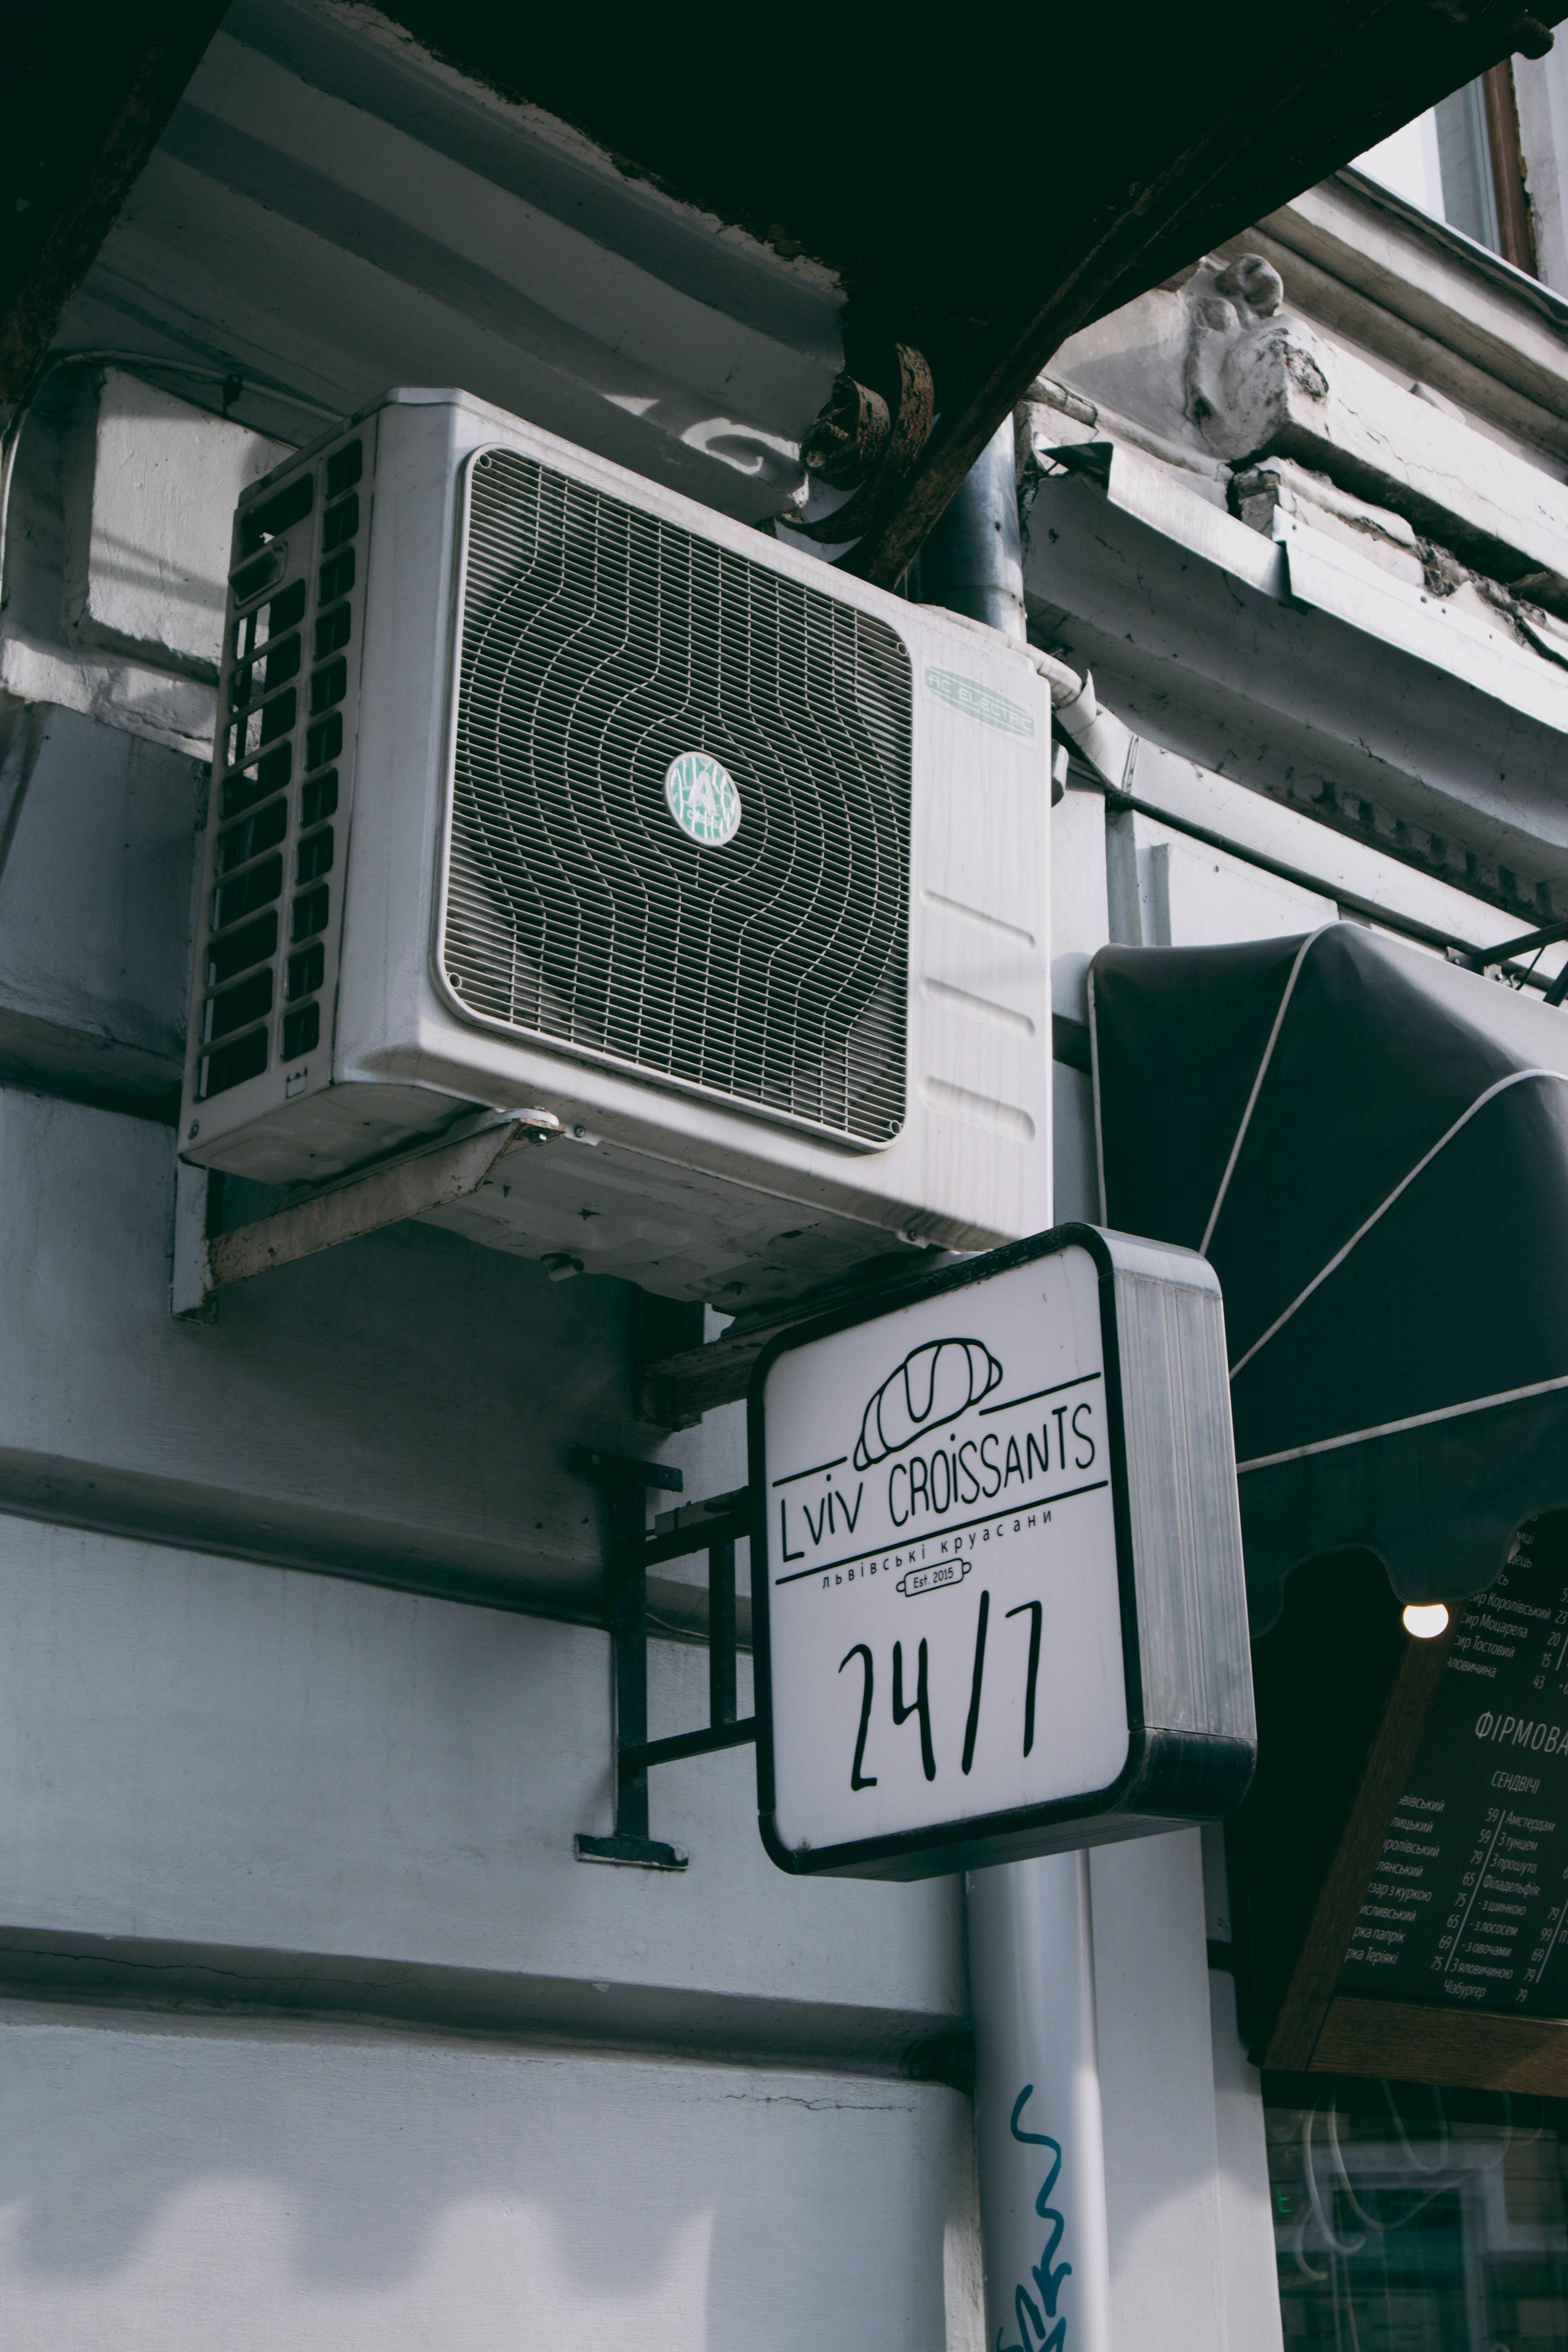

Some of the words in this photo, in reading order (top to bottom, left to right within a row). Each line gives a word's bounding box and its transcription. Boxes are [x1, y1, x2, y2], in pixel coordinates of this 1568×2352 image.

[928, 673, 953, 694] AC
[957, 687, 1032, 733] ELECTRIC
[822, 1544, 926, 1589] львівські
[940, 1510, 1052, 1554] круасани
[913, 1576, 931, 1589] Est.
[933, 1567, 954, 1584] 2015
[1487, 1592, 1551, 1620] Королівський
[1479, 1613, 1529, 1638] Моцарела
[1548, 1631, 1561, 1646] 20
[1473, 1635, 1515, 1659] Тостовий
[1541, 1653, 1553, 1668] 15
[838, 1590, 1043, 1791] 24/7
[1533, 1675, 1546, 1689] 43
[1491, 1771, 1541, 1794] СЕНДВІЧІ
[1485, 1808, 1499, 1822] 59
[1505, 1811, 1555, 1833] Амстердам
[1477, 1829, 1492, 1844] 59
[1506, 1837, 1538, 1851] тунцем
[1383, 1839, 1441, 1857] ролівський
[1470, 1850, 1484, 1865] 79
[1375, 1861, 1423, 1878] лянський
[1462, 1872, 1477, 1886] 65
[1497, 1858, 1537, 1876] прошуто
[1395, 1887, 1433, 1902] куркою
[1455, 1893, 1468, 1907] 75
[1483, 1874, 1541, 1898] Філадельфія:
[1446, 1914, 1460, 1928] 65
[1488, 1901, 1526, 1916] шинкою
[1547, 1907, 1560, 1920] 79
[1373, 1930, 1406, 1946] папрік
[1438, 1935, 1453, 1949] 69
[1480, 1922, 1519, 1937] лососем
[1539, 1927, 1553, 1942] 99
[1366, 1947, 1401, 1966] Теріякі
[1430, 1956, 1444, 1970] 75
[1472, 1943, 1512, 1958] овочами
[1531, 1948, 1545, 1962] 69
[1457, 1963, 1514, 1980] яловичиною
[1523, 1968, 1537, 1982] 79
[1443, 1979, 1487, 2001] Чізбургер
[1515, 1988, 1529, 2003] 79
